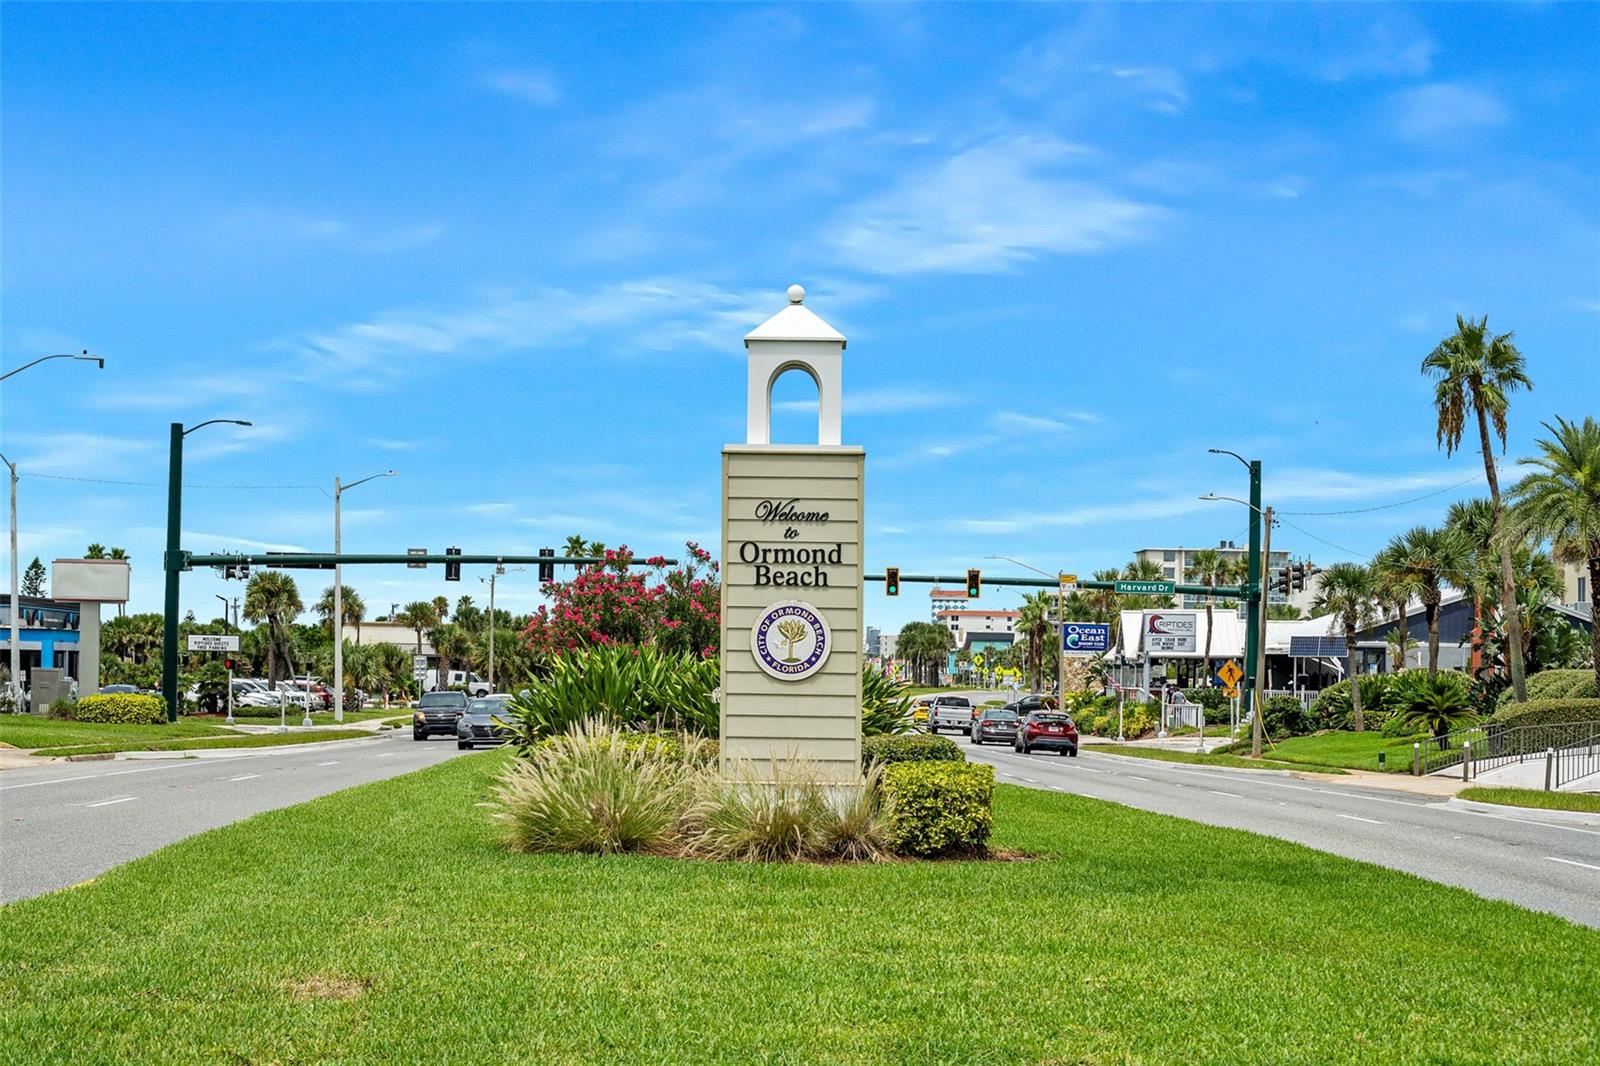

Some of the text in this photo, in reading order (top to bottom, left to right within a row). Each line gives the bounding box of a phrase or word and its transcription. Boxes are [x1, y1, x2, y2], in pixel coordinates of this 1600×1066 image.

[755, 498, 830, 522] Welcome
[784, 526, 799, 539] to
[739, 541, 842, 565] Ormond
[754, 564, 829, 587] Beach
[1120, 583, 1157, 591] Harvard
[758, 607, 824, 656] CITY OF ORMOND BEACH
[1068, 625, 1105, 634] Ocean
[771, 661, 811, 673] FLORIDA
